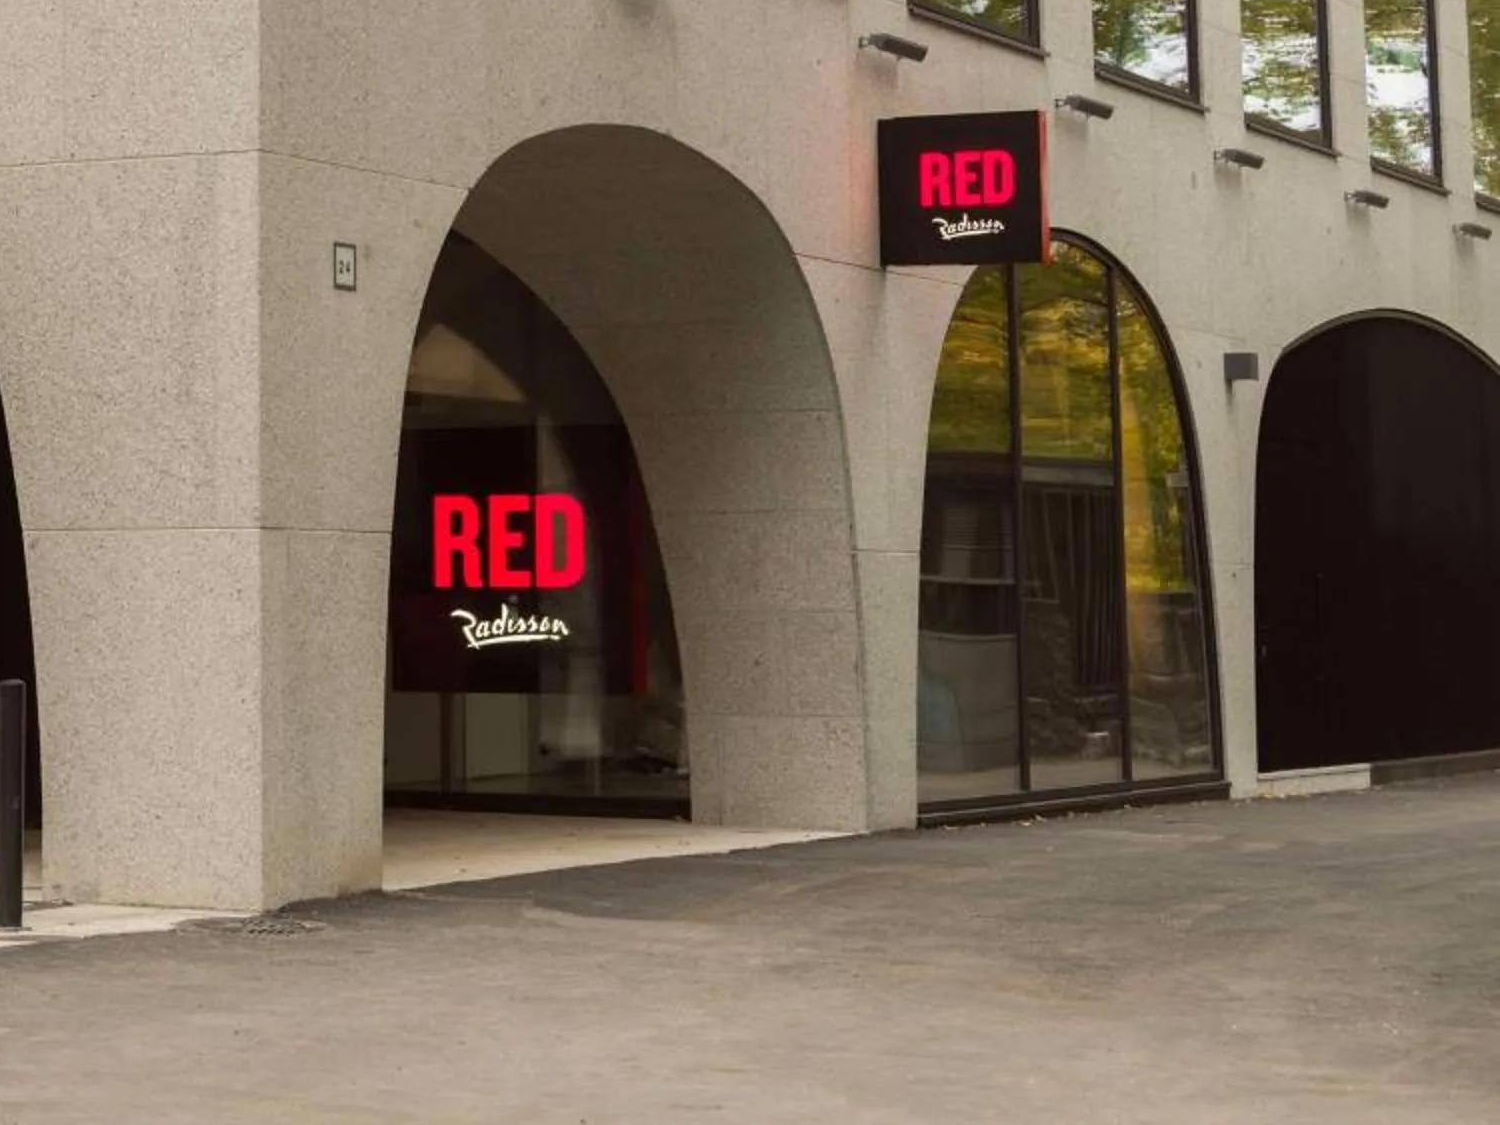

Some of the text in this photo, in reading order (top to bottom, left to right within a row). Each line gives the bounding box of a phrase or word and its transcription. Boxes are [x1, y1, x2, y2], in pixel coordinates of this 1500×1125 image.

[919, 148, 1016, 208] RED
[931, 213, 1005, 241] Radisson
[433, 493, 586, 589] RED
[450, 603, 570, 650] Radisson
